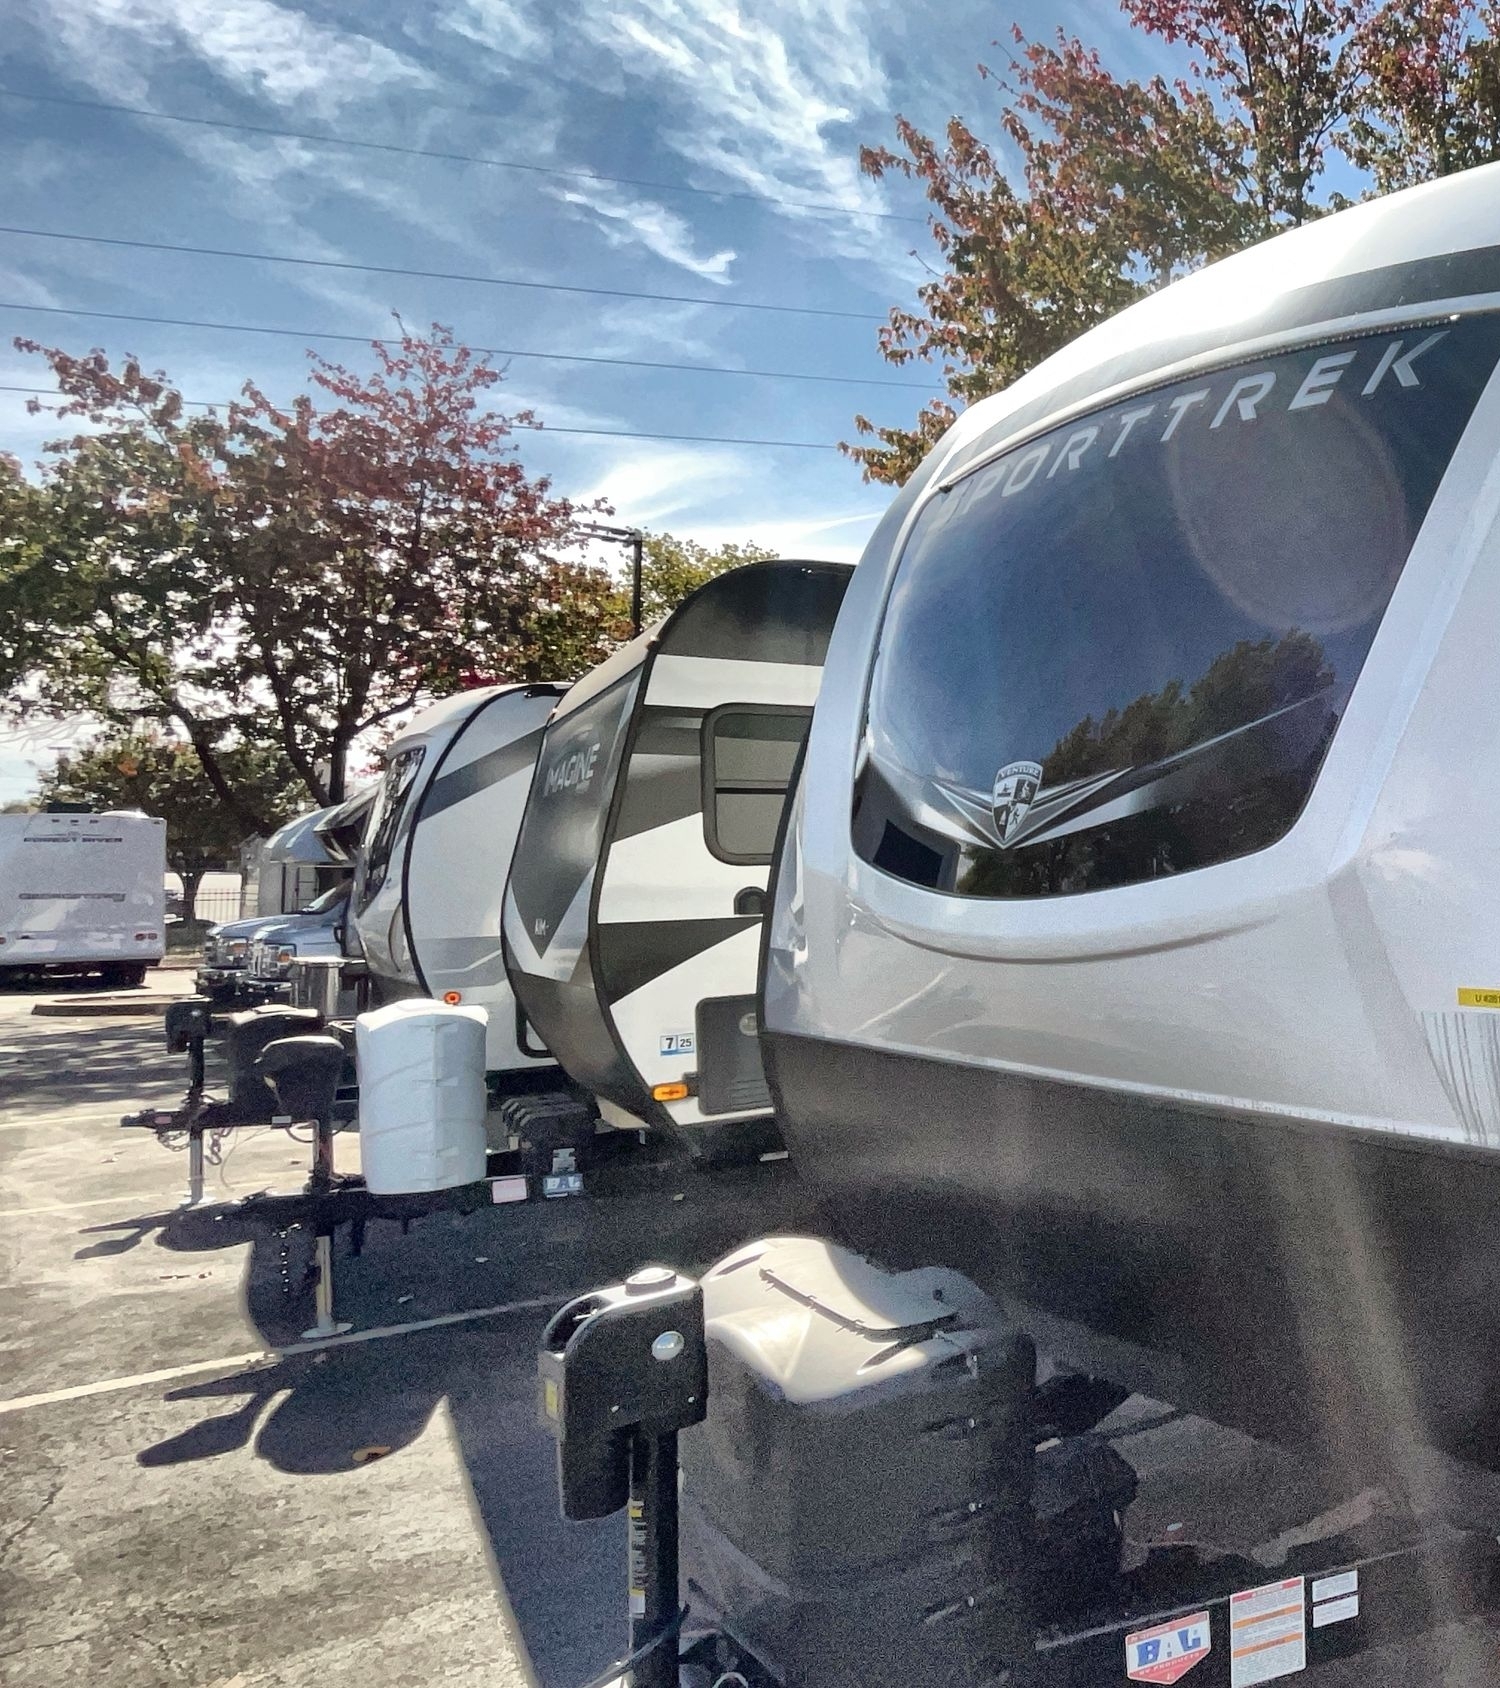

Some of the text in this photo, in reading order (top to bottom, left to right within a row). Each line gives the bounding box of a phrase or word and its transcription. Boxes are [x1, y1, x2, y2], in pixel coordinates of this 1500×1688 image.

[543, 743, 600, 799] IMAGINE
[1000, 766, 1040, 778] VENTURE
[1475, 994, 1482, 1003] U
[665, 1037, 692, 1050] 7 25
